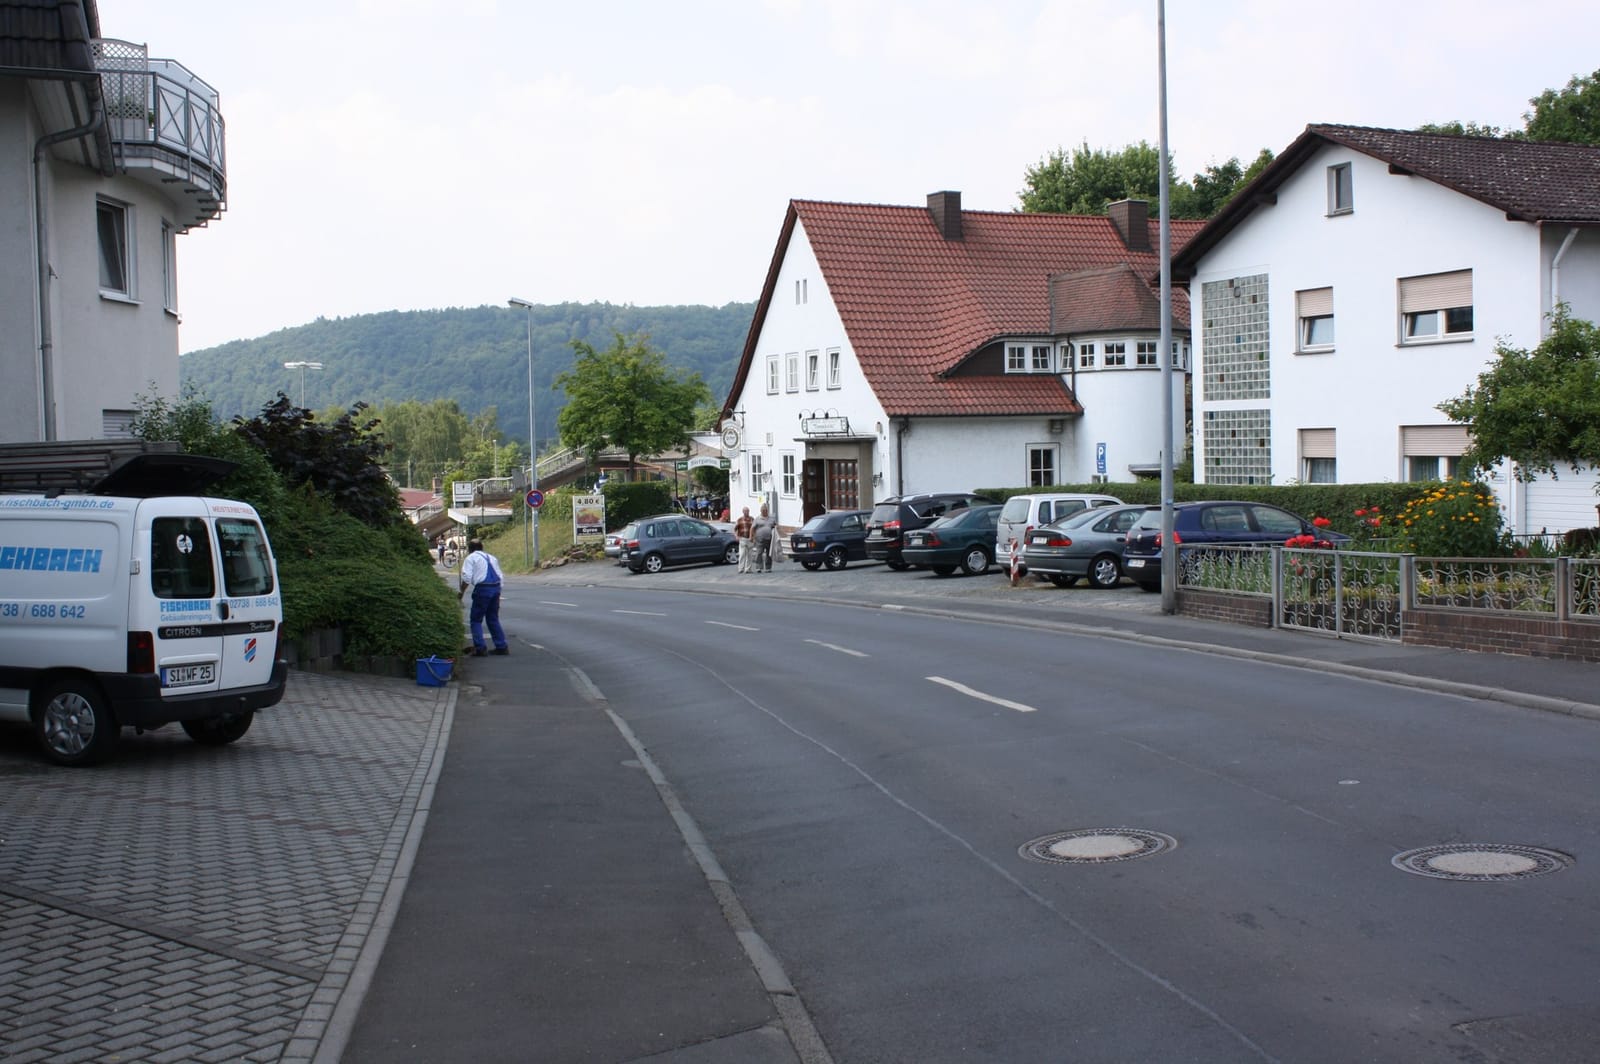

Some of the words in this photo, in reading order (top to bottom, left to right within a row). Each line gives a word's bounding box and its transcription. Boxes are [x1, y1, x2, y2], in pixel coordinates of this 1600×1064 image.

[1098, 446, 1104, 460] P
[0, 547, 103, 573] CHBACH
[160, 600, 211, 612] FISCHBACH
[230, 599, 250, 608] 02738
[31, 604, 56, 618] 688
[60, 605, 86, 619] 642
[165, 627, 202, 637] CITROËN
[170, 669, 181, 682] SI
[185, 668, 198, 681] WF
[200, 666, 211, 679] 25
